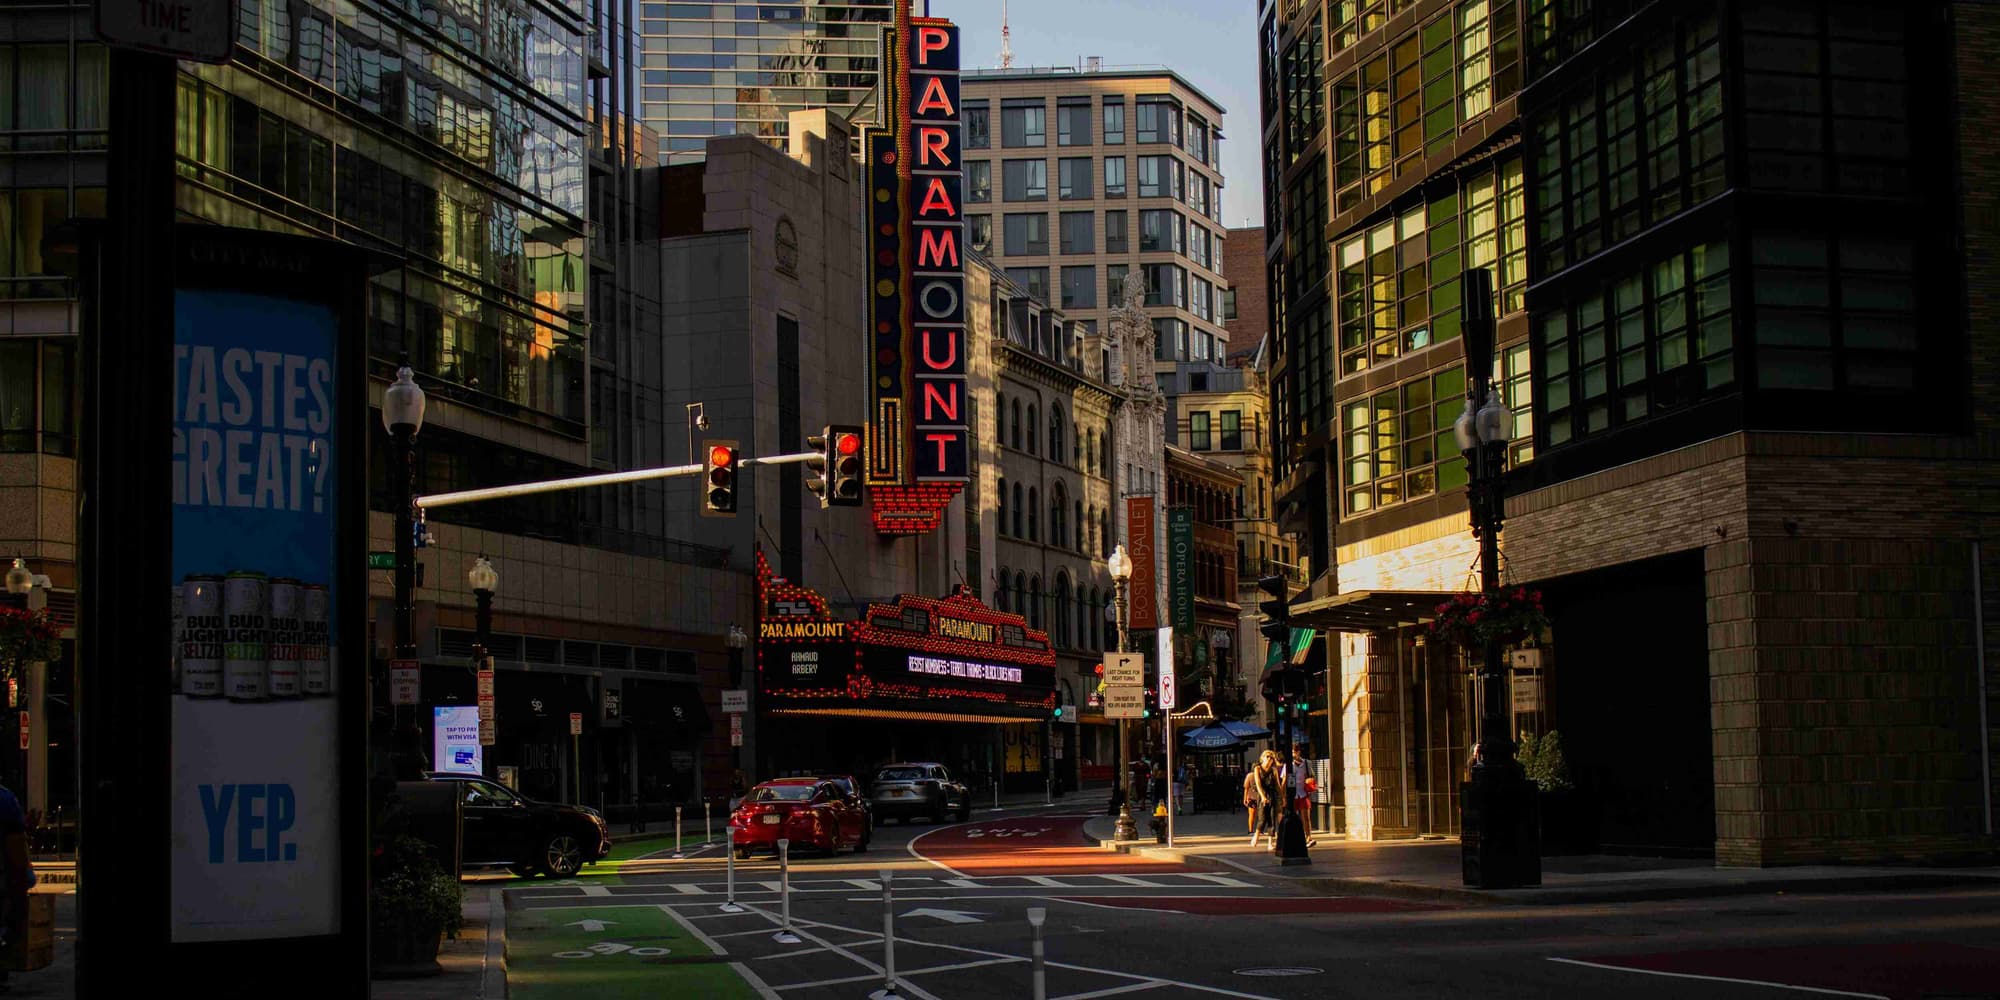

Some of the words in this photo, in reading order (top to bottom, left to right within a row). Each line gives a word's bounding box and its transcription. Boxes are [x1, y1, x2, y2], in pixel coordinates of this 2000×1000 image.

[138, 0, 192, 33] TIME
[917, 26, 960, 474] PARAMOUNT
[1175, 542, 1187, 586] OPERA
[1176, 588, 1187, 629] HOUSE
[187, 615, 222, 628] BUD
[229, 614, 264, 628] BUD
[271, 617, 299, 631] BUD
[760, 622, 845, 638] PARAMOUNT
[939, 617, 994, 643] PARAMOUNT
[791, 651, 818, 662] AHMAUD
[792, 663, 818, 674] ARBERY
[198, 783, 297, 864] YEP.
